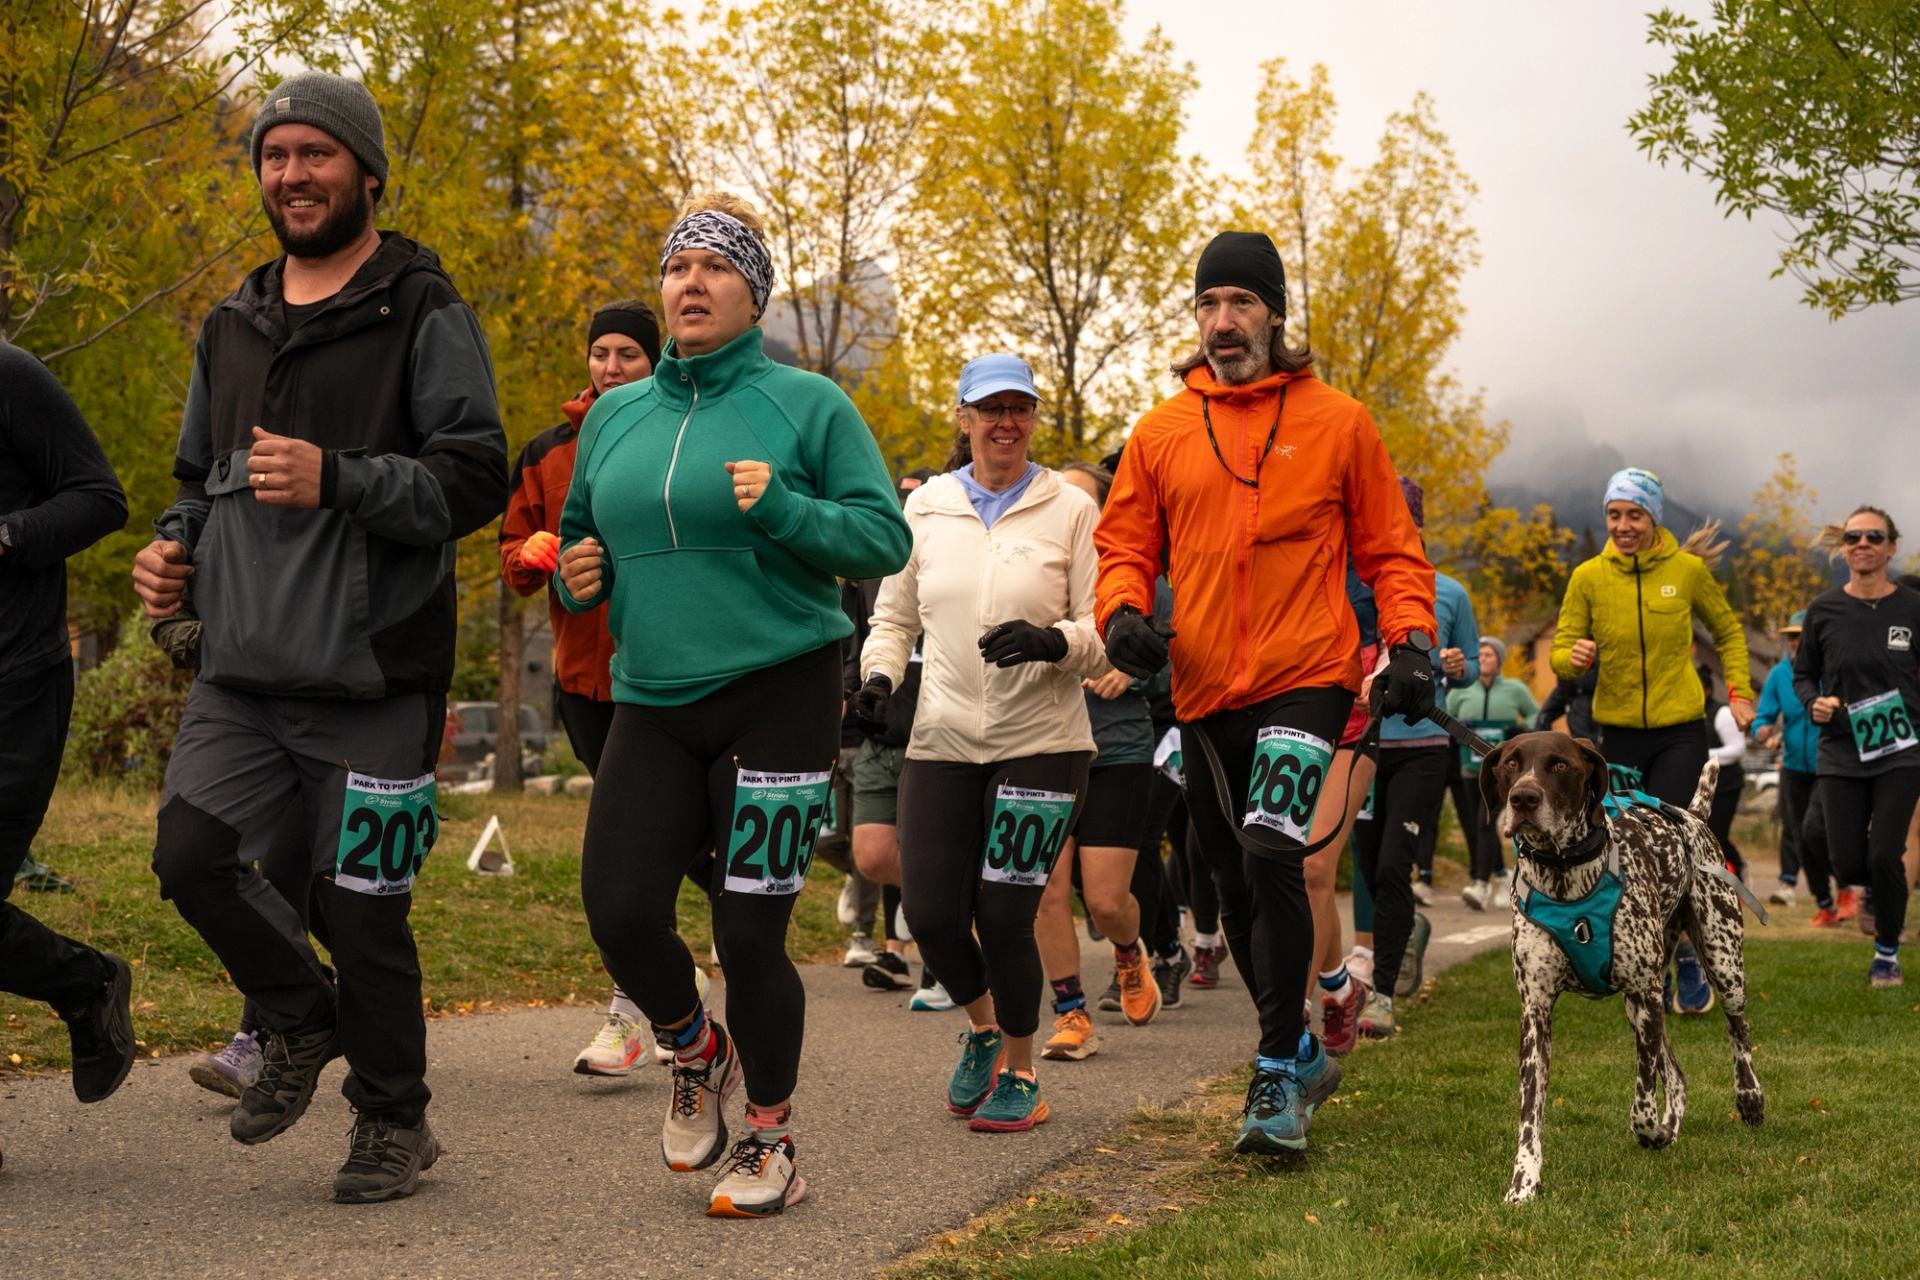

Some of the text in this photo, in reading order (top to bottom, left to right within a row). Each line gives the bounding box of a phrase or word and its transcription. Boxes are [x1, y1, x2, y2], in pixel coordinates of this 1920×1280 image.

[1284, 730, 1306, 739] PINTS
[1856, 706, 1911, 754] 226
[354, 779, 413, 790] PARK TO PINTS
[743, 775, 763, 783] PARK
[779, 775, 800, 783] PINTS
[1246, 752, 1322, 828] 269
[341, 804, 435, 881] 203
[728, 804, 823, 880] 205
[988, 810, 1065, 874] 304
